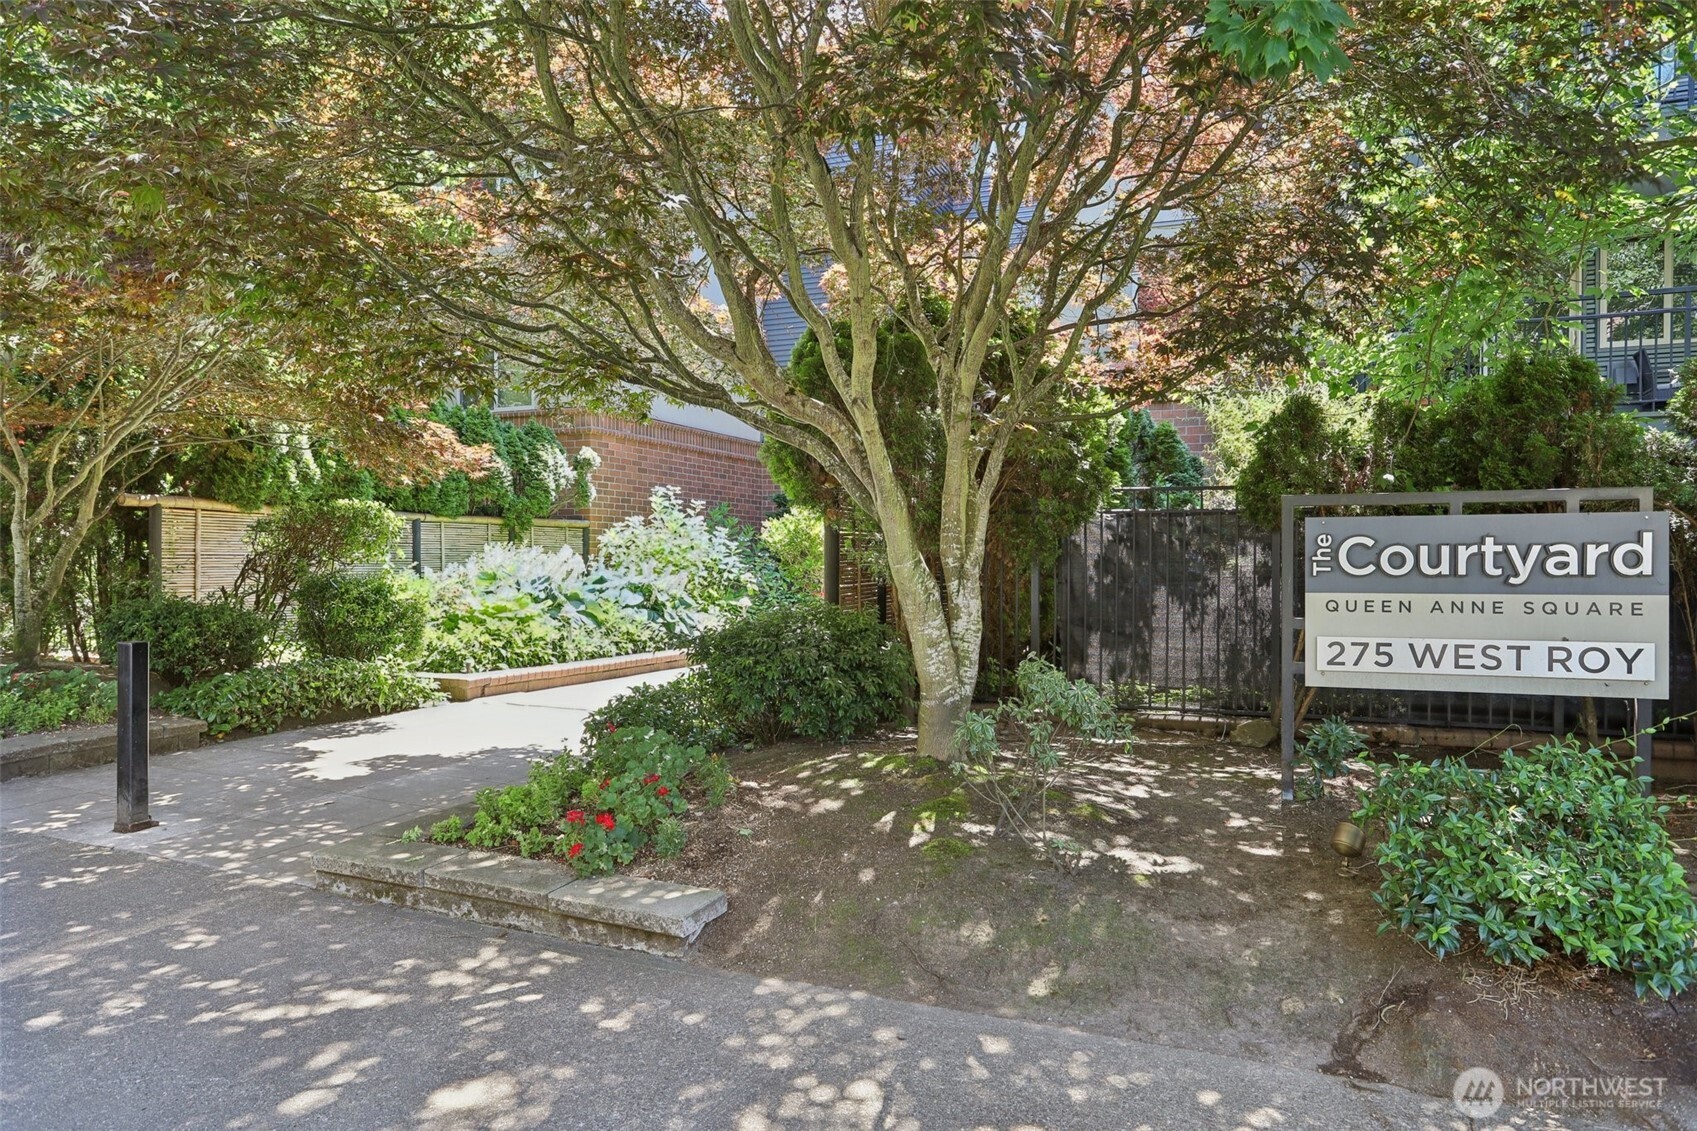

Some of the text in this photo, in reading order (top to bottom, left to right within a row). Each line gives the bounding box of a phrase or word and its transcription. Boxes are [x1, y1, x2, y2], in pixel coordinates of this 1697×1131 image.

[1311, 533, 1333, 577] The
[1337, 530, 1654, 586] Courtyard
[1325, 599, 1644, 616] QUEEN ANNE SQUARE
[1326, 640, 1644, 675] 275 WEST ROY
